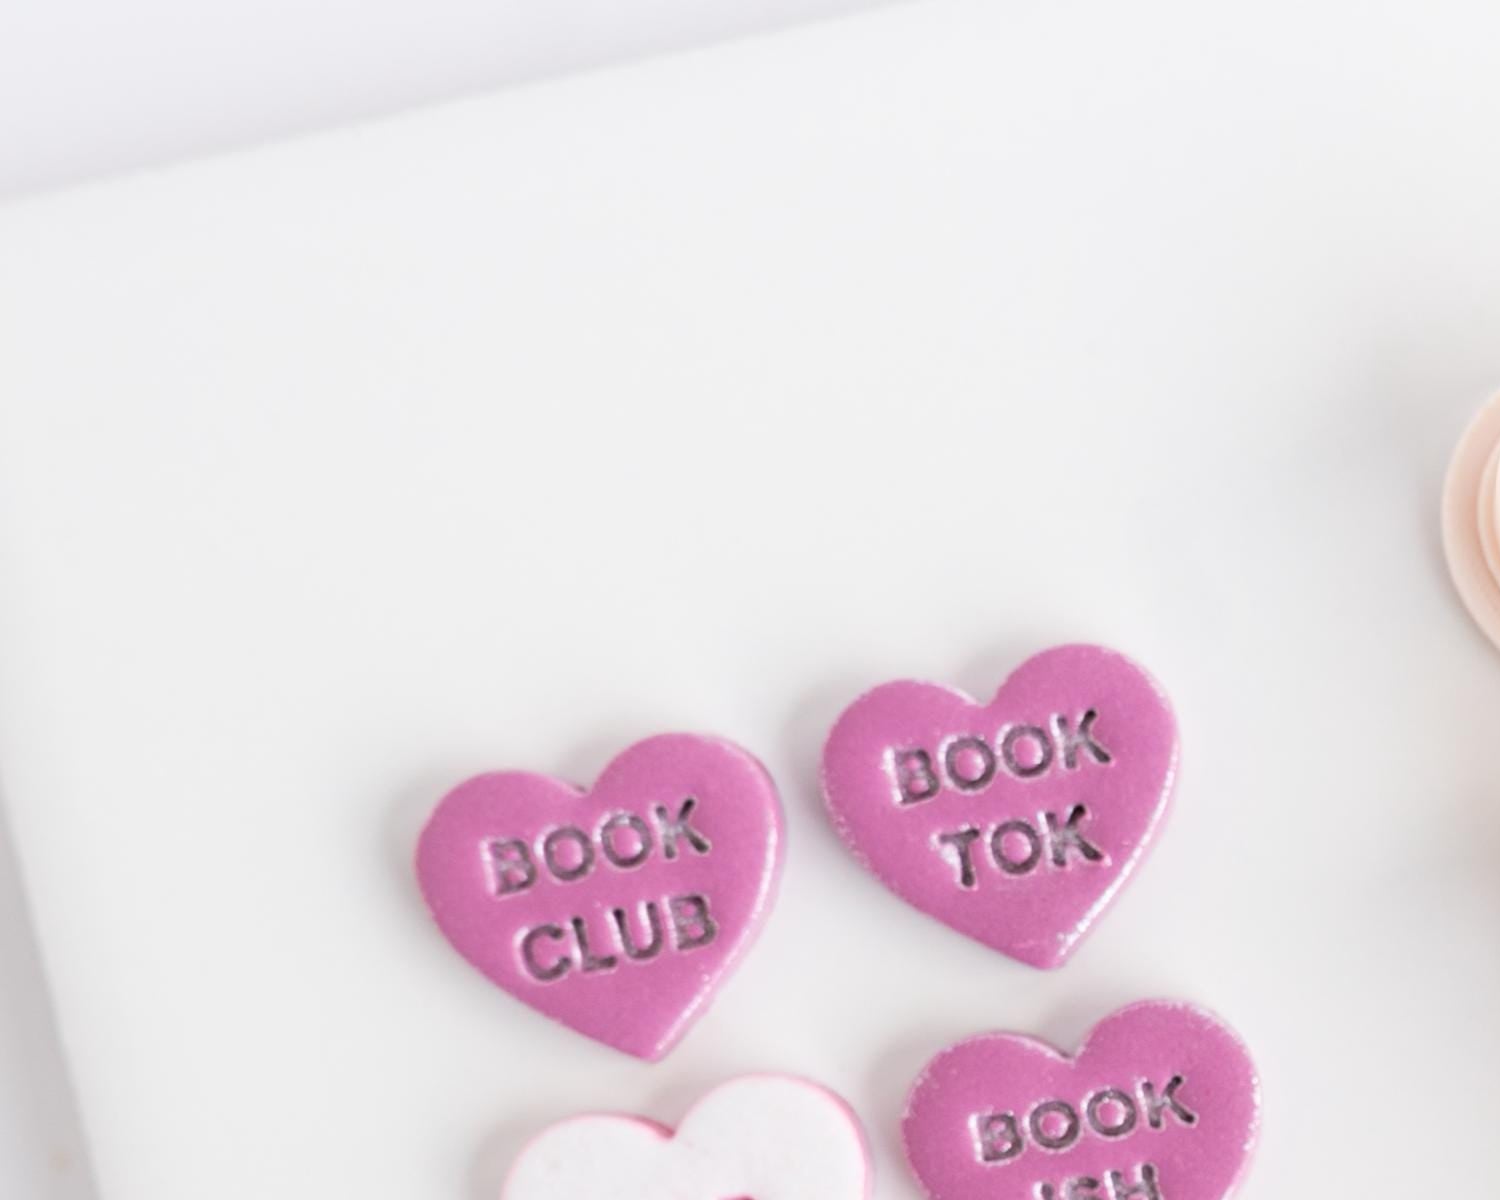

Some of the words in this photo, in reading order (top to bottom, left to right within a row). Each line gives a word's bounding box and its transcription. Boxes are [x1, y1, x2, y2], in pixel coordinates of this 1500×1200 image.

[886, 709, 1111, 805] BOOK
[484, 798, 709, 897] BOOK
[938, 805, 1103, 887] TOK
[516, 894, 717, 980] CLUB
[970, 1075, 1195, 1162] BOOK
